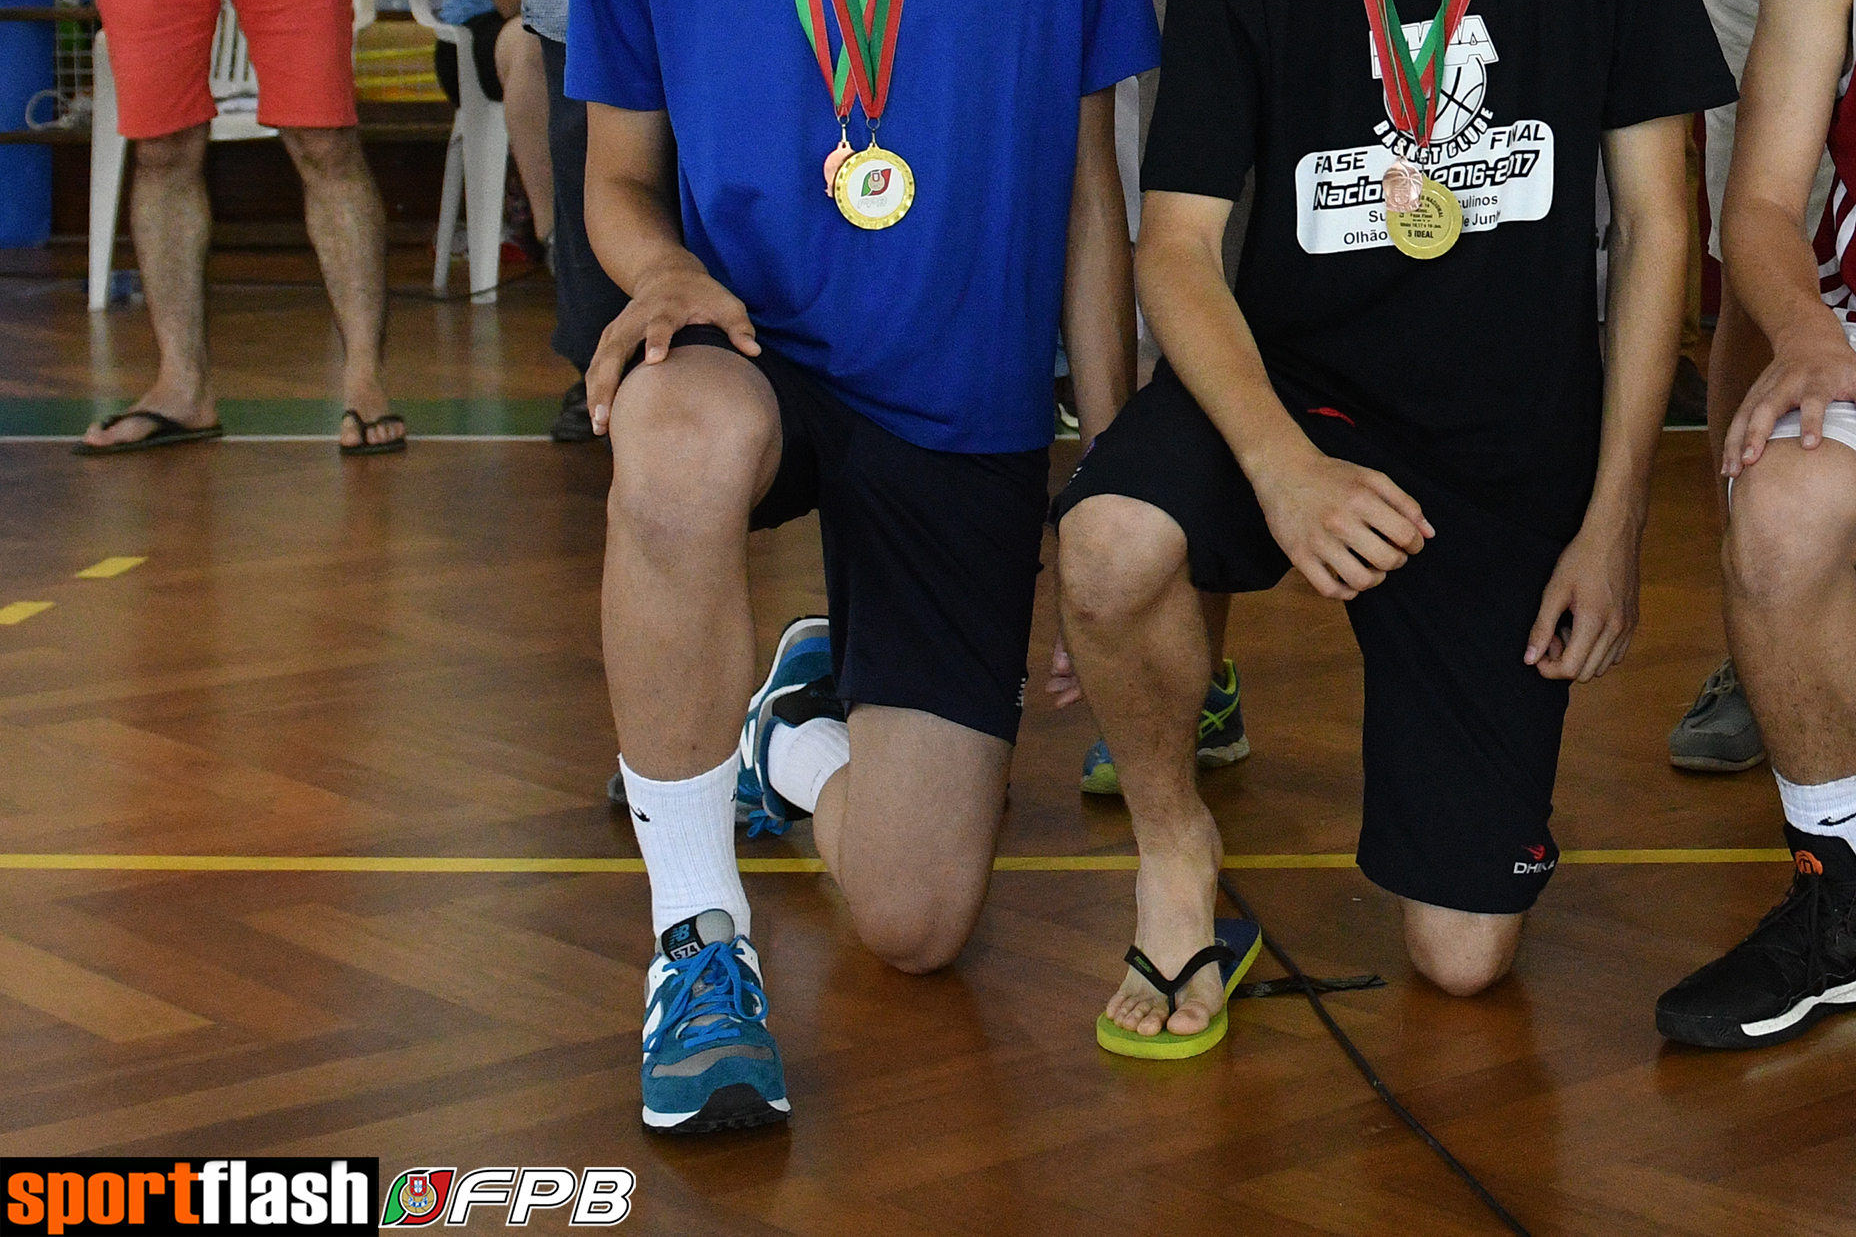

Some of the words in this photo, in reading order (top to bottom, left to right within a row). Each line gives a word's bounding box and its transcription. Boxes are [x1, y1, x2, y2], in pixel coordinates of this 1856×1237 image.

[1315, 150, 1369, 174] FASE
[1490, 124, 1546, 150] FINAL
[1414, 230, 1434, 239] IDEAL
[674, 944, 698, 960] 574
